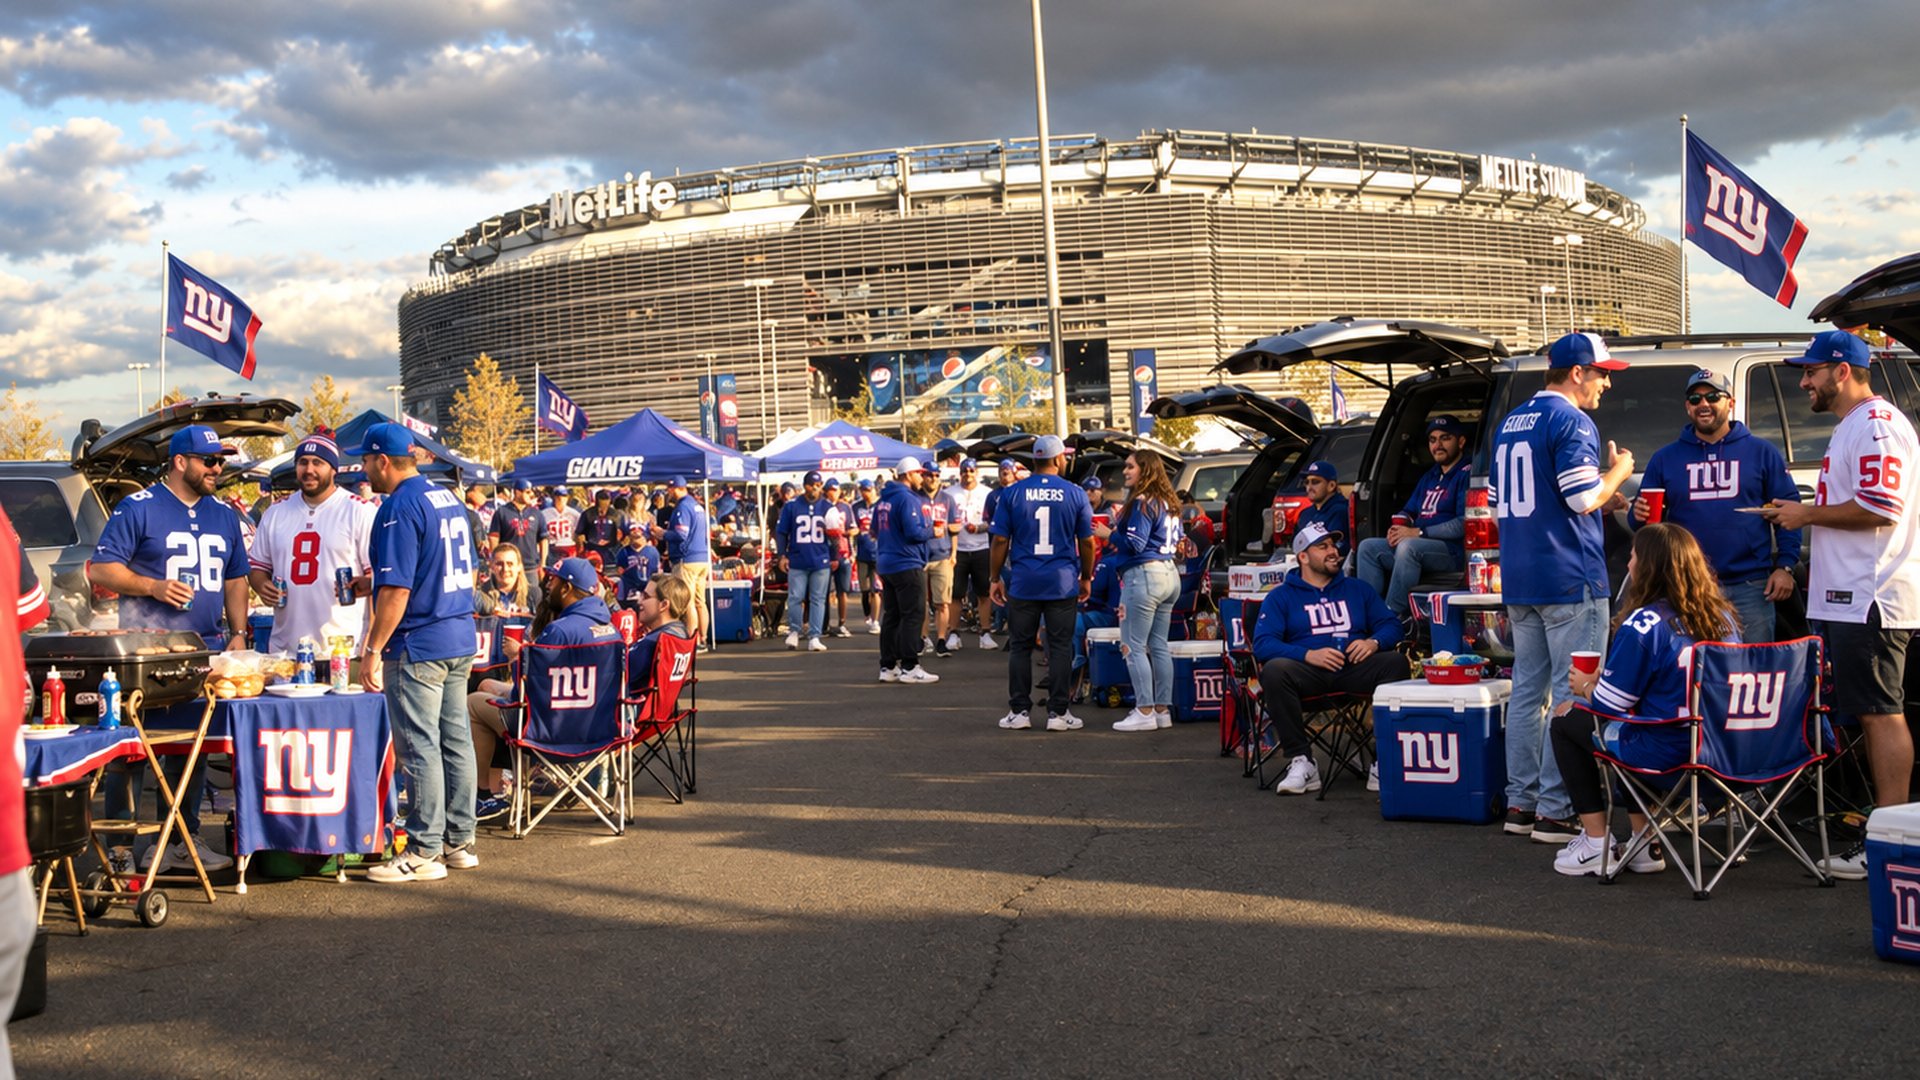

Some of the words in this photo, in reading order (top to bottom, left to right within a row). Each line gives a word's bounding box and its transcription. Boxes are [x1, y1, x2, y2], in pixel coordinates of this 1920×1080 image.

[550, 171, 677, 229] MetLife
[1481, 154, 1538, 194] METLIFE
[1703, 161, 1769, 256] ny
[183, 277, 233, 344] ny
[566, 456, 645, 479] GIANTS
[1495, 441, 1536, 518] 10
[1686, 460, 1740, 501] ny
[1859, 454, 1902, 491] 56
[440, 516, 474, 594] 13
[796, 515, 825, 543] 26
[1034, 506, 1054, 556] 1
[166, 531, 226, 592] 26
[291, 531, 321, 586] 8
[1304, 600, 1352, 635] ny
[472, 631, 492, 664] y
[549, 666, 597, 710] ny
[1725, 671, 1787, 730] ny
[258, 728, 353, 817] ny
[1397, 731, 1460, 784] ny
